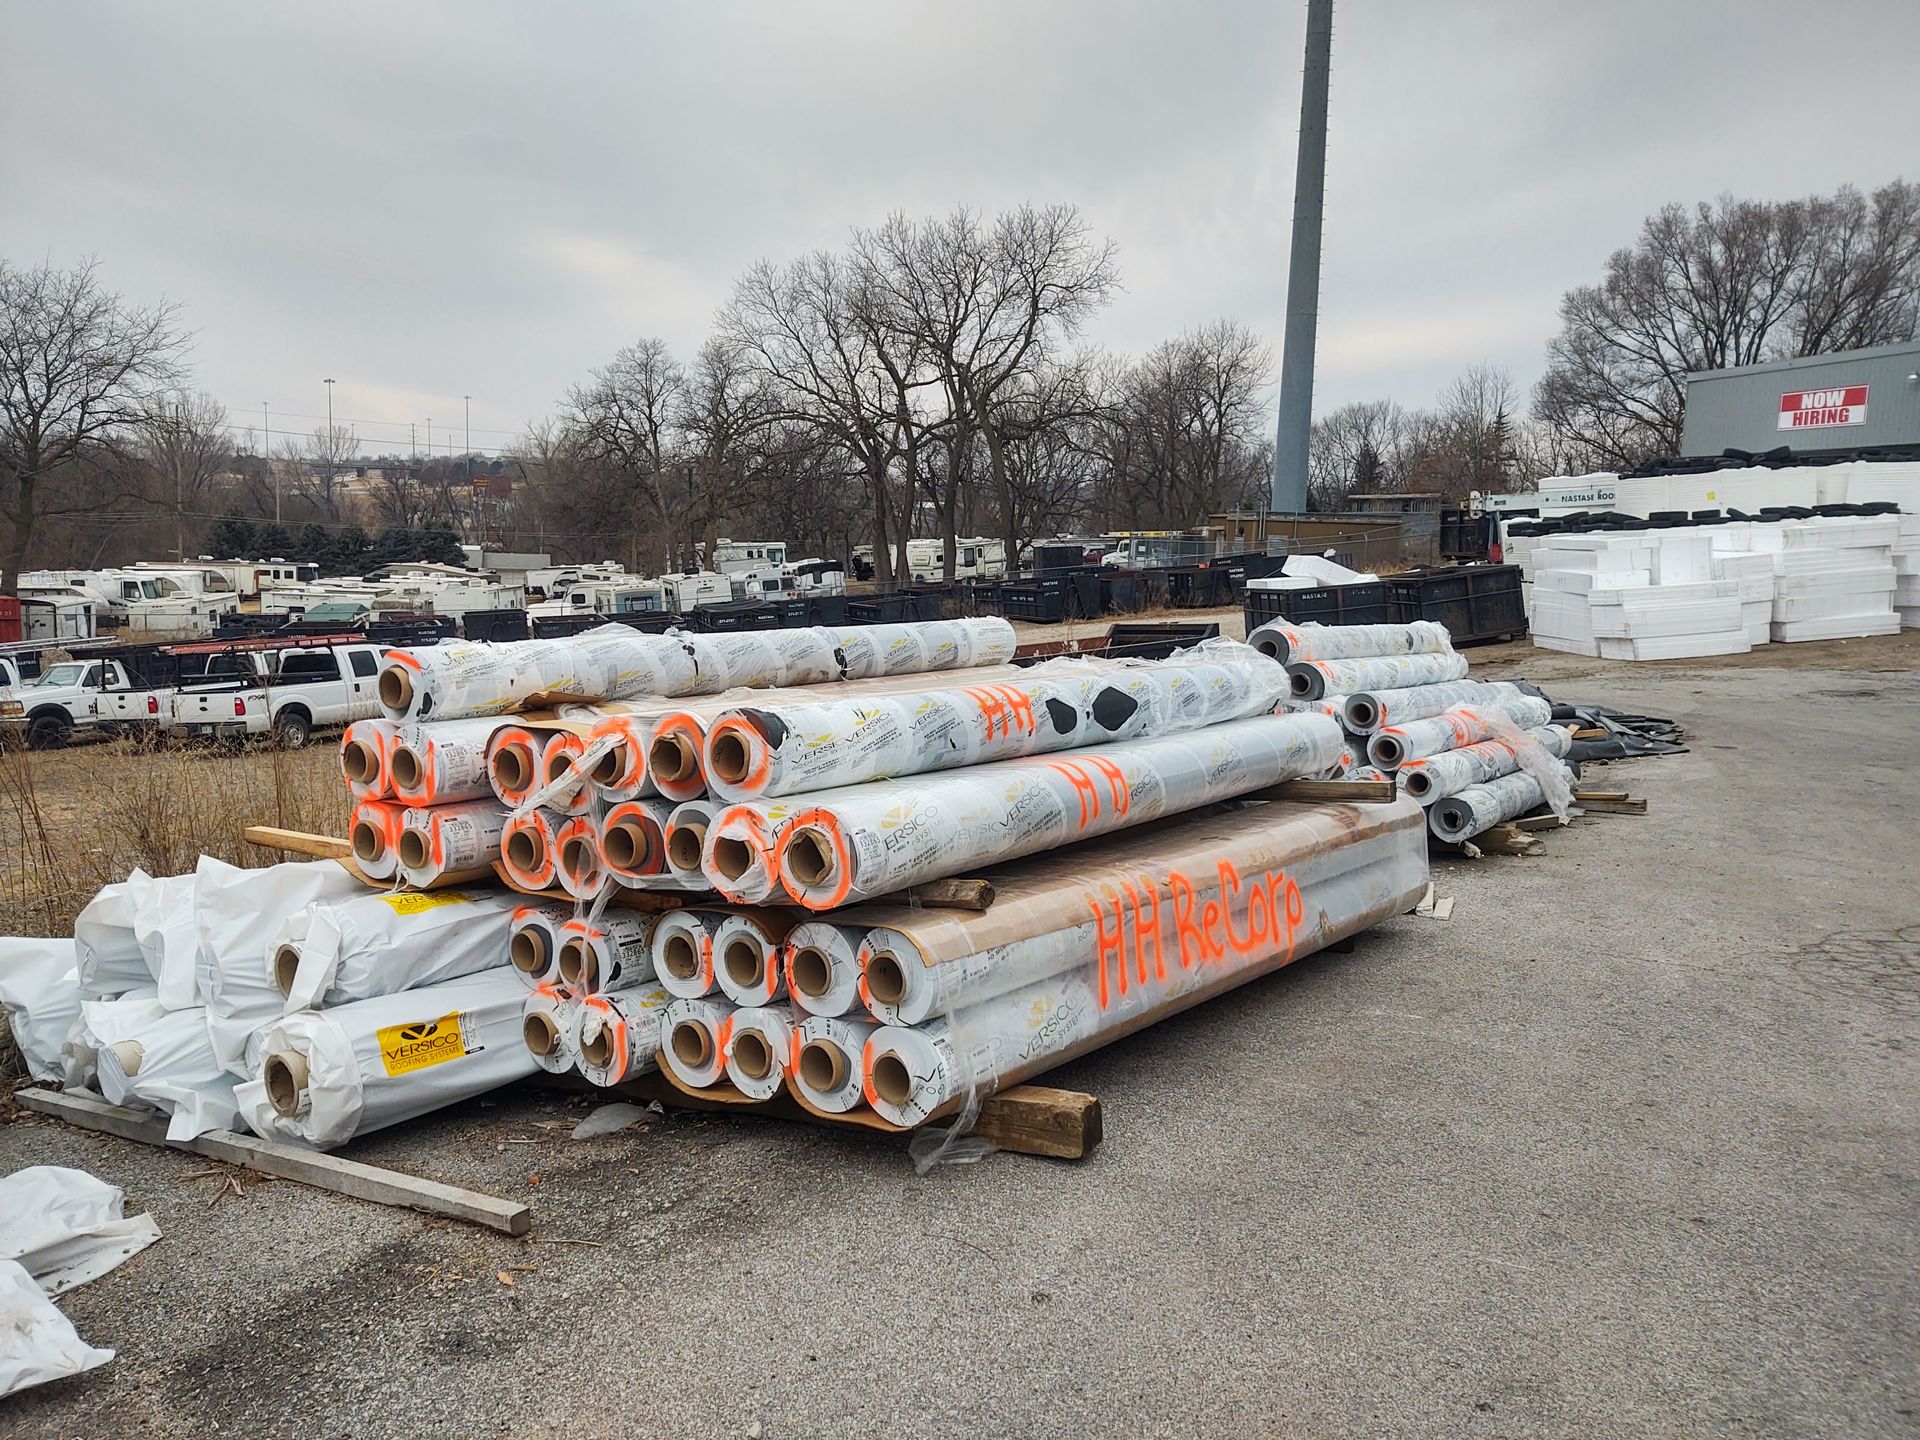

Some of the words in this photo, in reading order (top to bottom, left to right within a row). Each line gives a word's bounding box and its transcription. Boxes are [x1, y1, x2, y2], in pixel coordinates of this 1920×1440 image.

[1801, 390, 1846, 409] NOW
[1792, 408, 1850, 426] HIRING
[1561, 494, 1595, 503] NASTASE
[883, 805, 939, 851] ERSICO
[1089, 879, 1166, 1012] HH
[1169, 858, 1304, 969] ReCorp
[621, 949, 645, 960] 332865
[1018, 996, 1078, 1061] VERSICO
[386, 1032, 459, 1060] VERSICO
[390, 1055, 428, 1071] ROOFING
[428, 1046, 460, 1061] SYSTEMS
